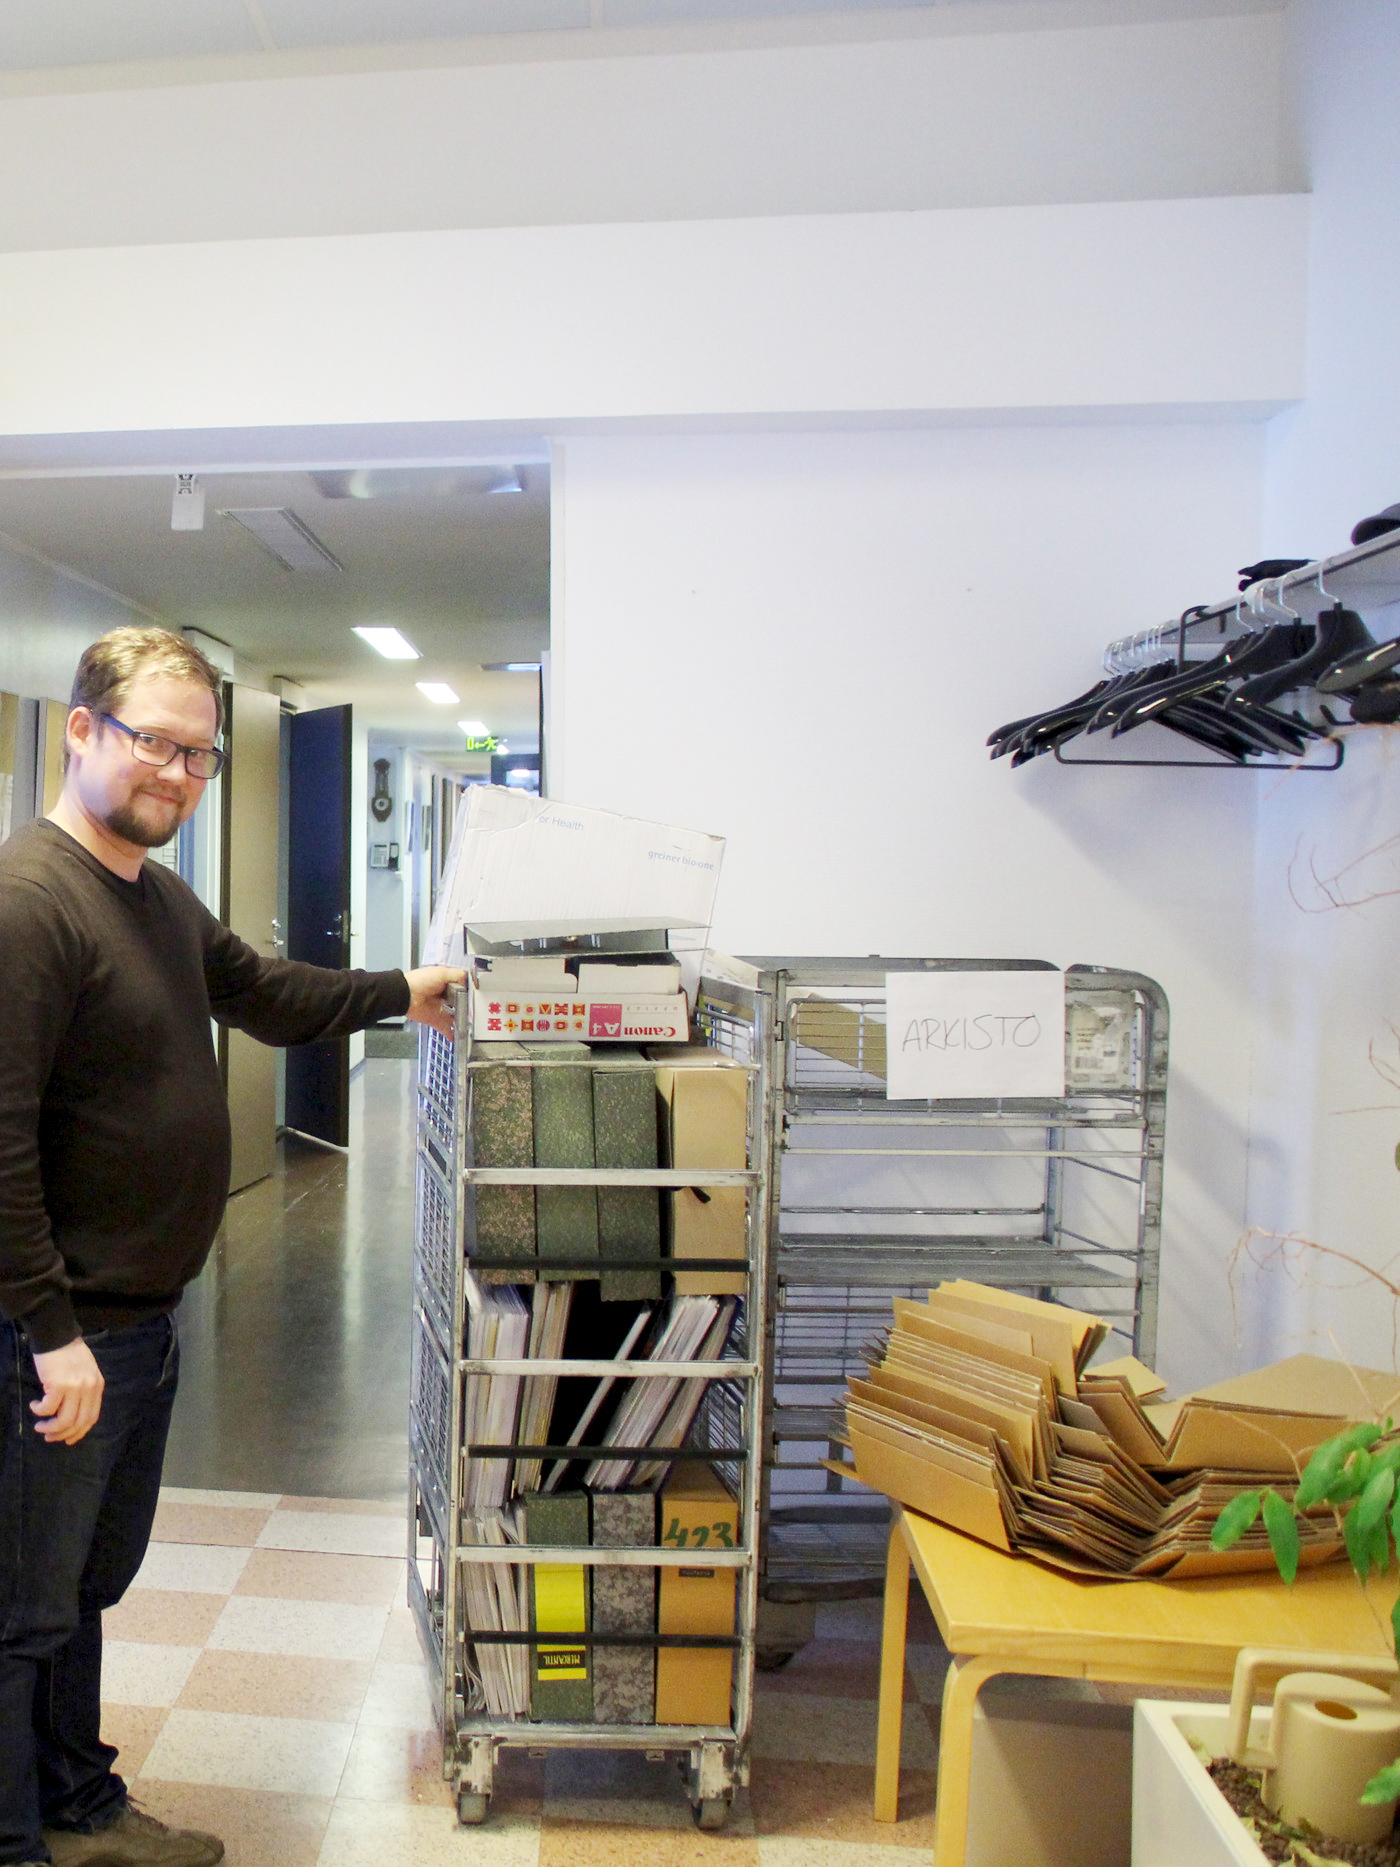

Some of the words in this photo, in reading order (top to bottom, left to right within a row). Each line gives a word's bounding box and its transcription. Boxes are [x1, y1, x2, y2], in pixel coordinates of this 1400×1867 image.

[552, 816, 585, 831] Health
[648, 850, 680, 863] greiner
[681, 855, 715, 870] bio-one
[592, 1022, 620, 1034] A4
[624, 1026, 676, 1037] Canon
[902, 1013, 1041, 1052] ARKISTO
